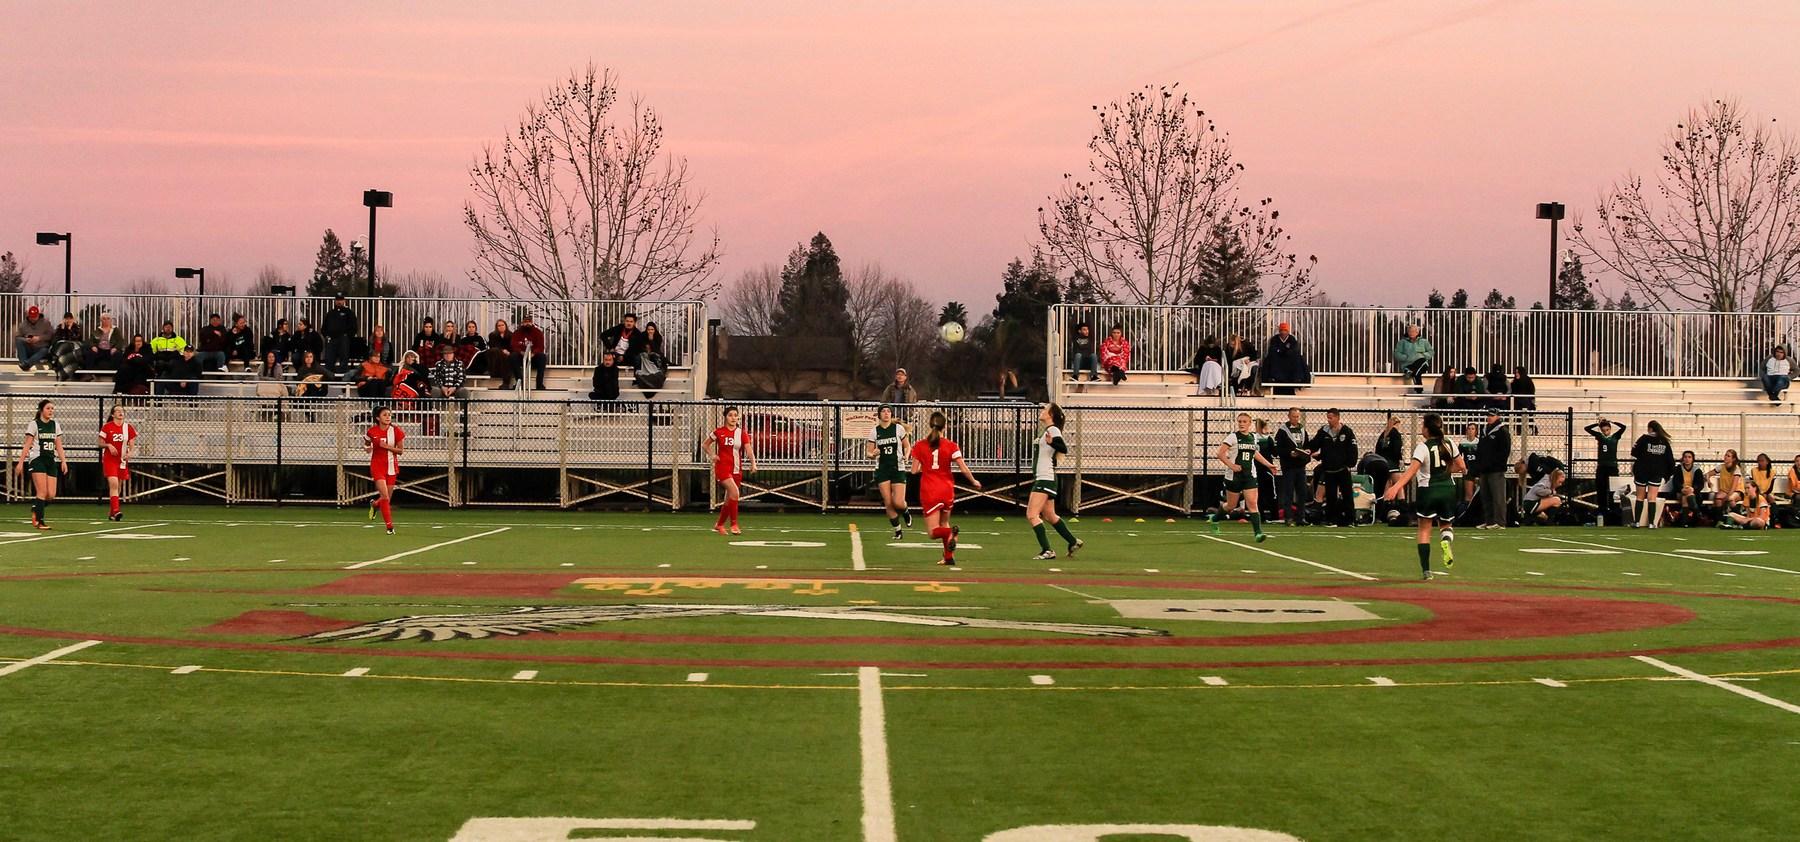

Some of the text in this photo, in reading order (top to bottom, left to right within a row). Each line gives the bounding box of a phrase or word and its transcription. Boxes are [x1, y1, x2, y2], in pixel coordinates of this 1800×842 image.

[113, 433, 123, 442] 23
[724, 437, 734, 446] 13
[43, 441, 54, 451] 20
[883, 446, 893, 455] 13
[931, 449, 940, 470] 1
[1242, 452, 1250, 461] 18
